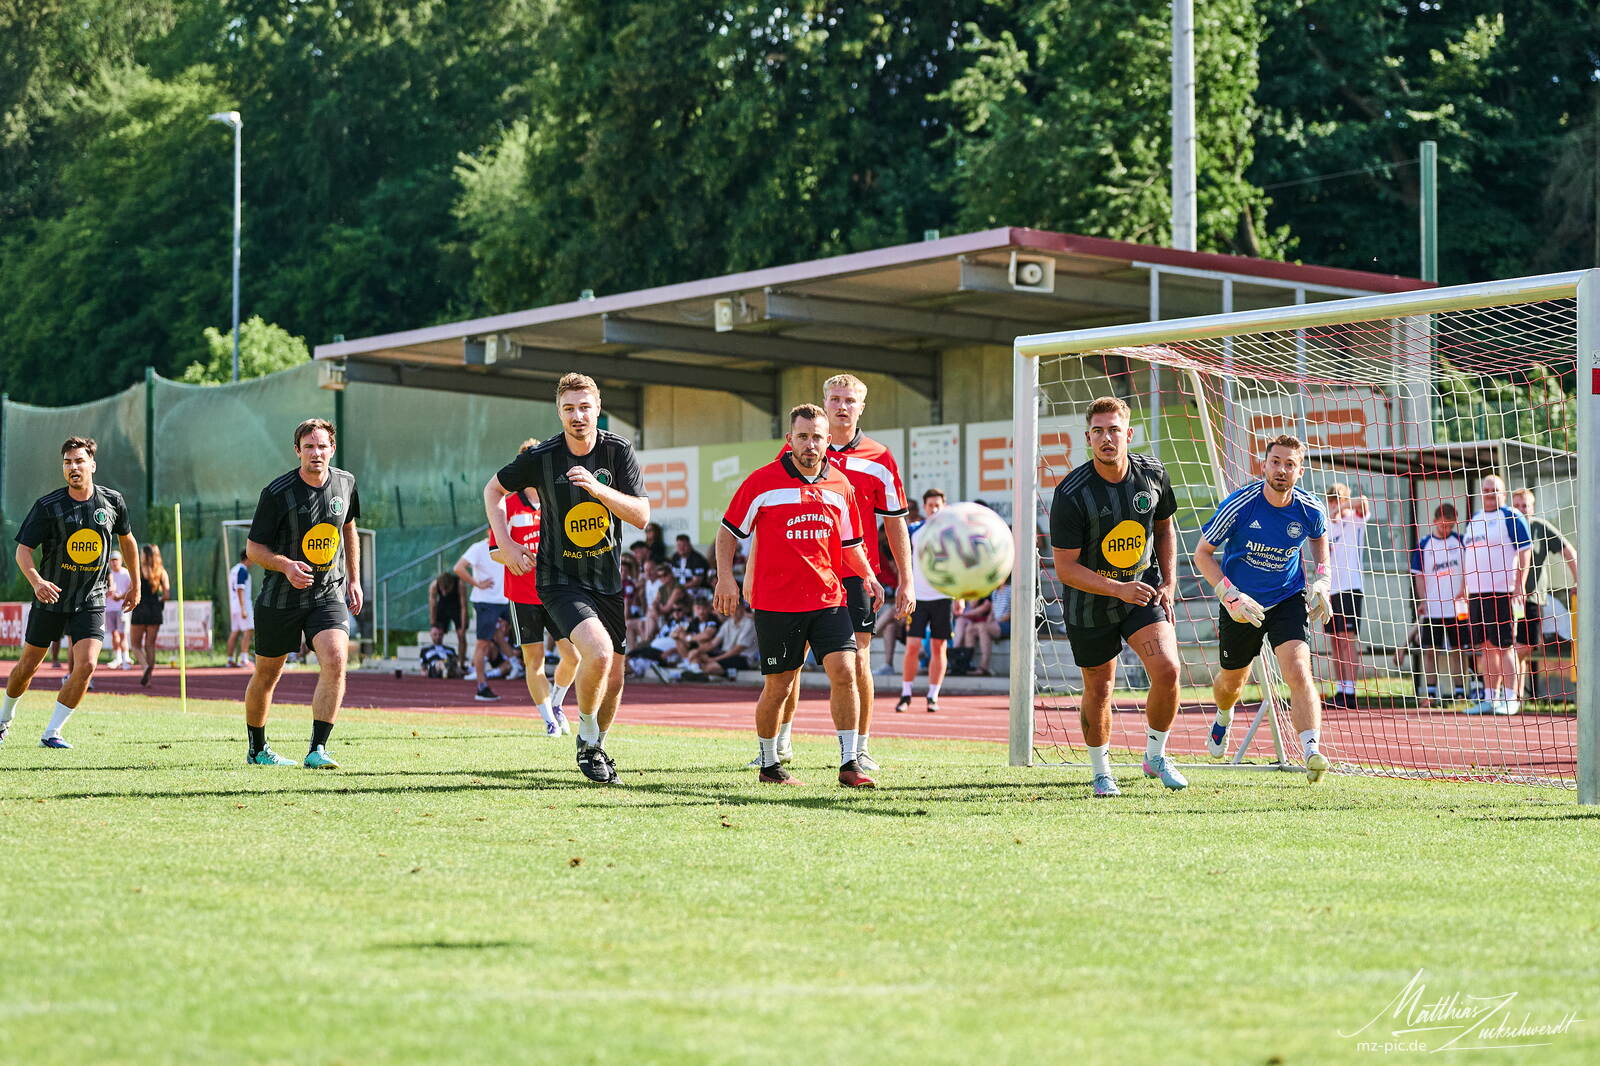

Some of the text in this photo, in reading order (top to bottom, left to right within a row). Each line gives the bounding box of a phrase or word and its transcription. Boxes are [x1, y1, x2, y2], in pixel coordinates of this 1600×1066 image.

[570, 516, 605, 533] ARAG
[71, 541, 98, 552] ARAG
[1108, 535, 1142, 552] ARAG
[1245, 540, 1285, 555] Allianz
[562, 549, 583, 559] ARAG
